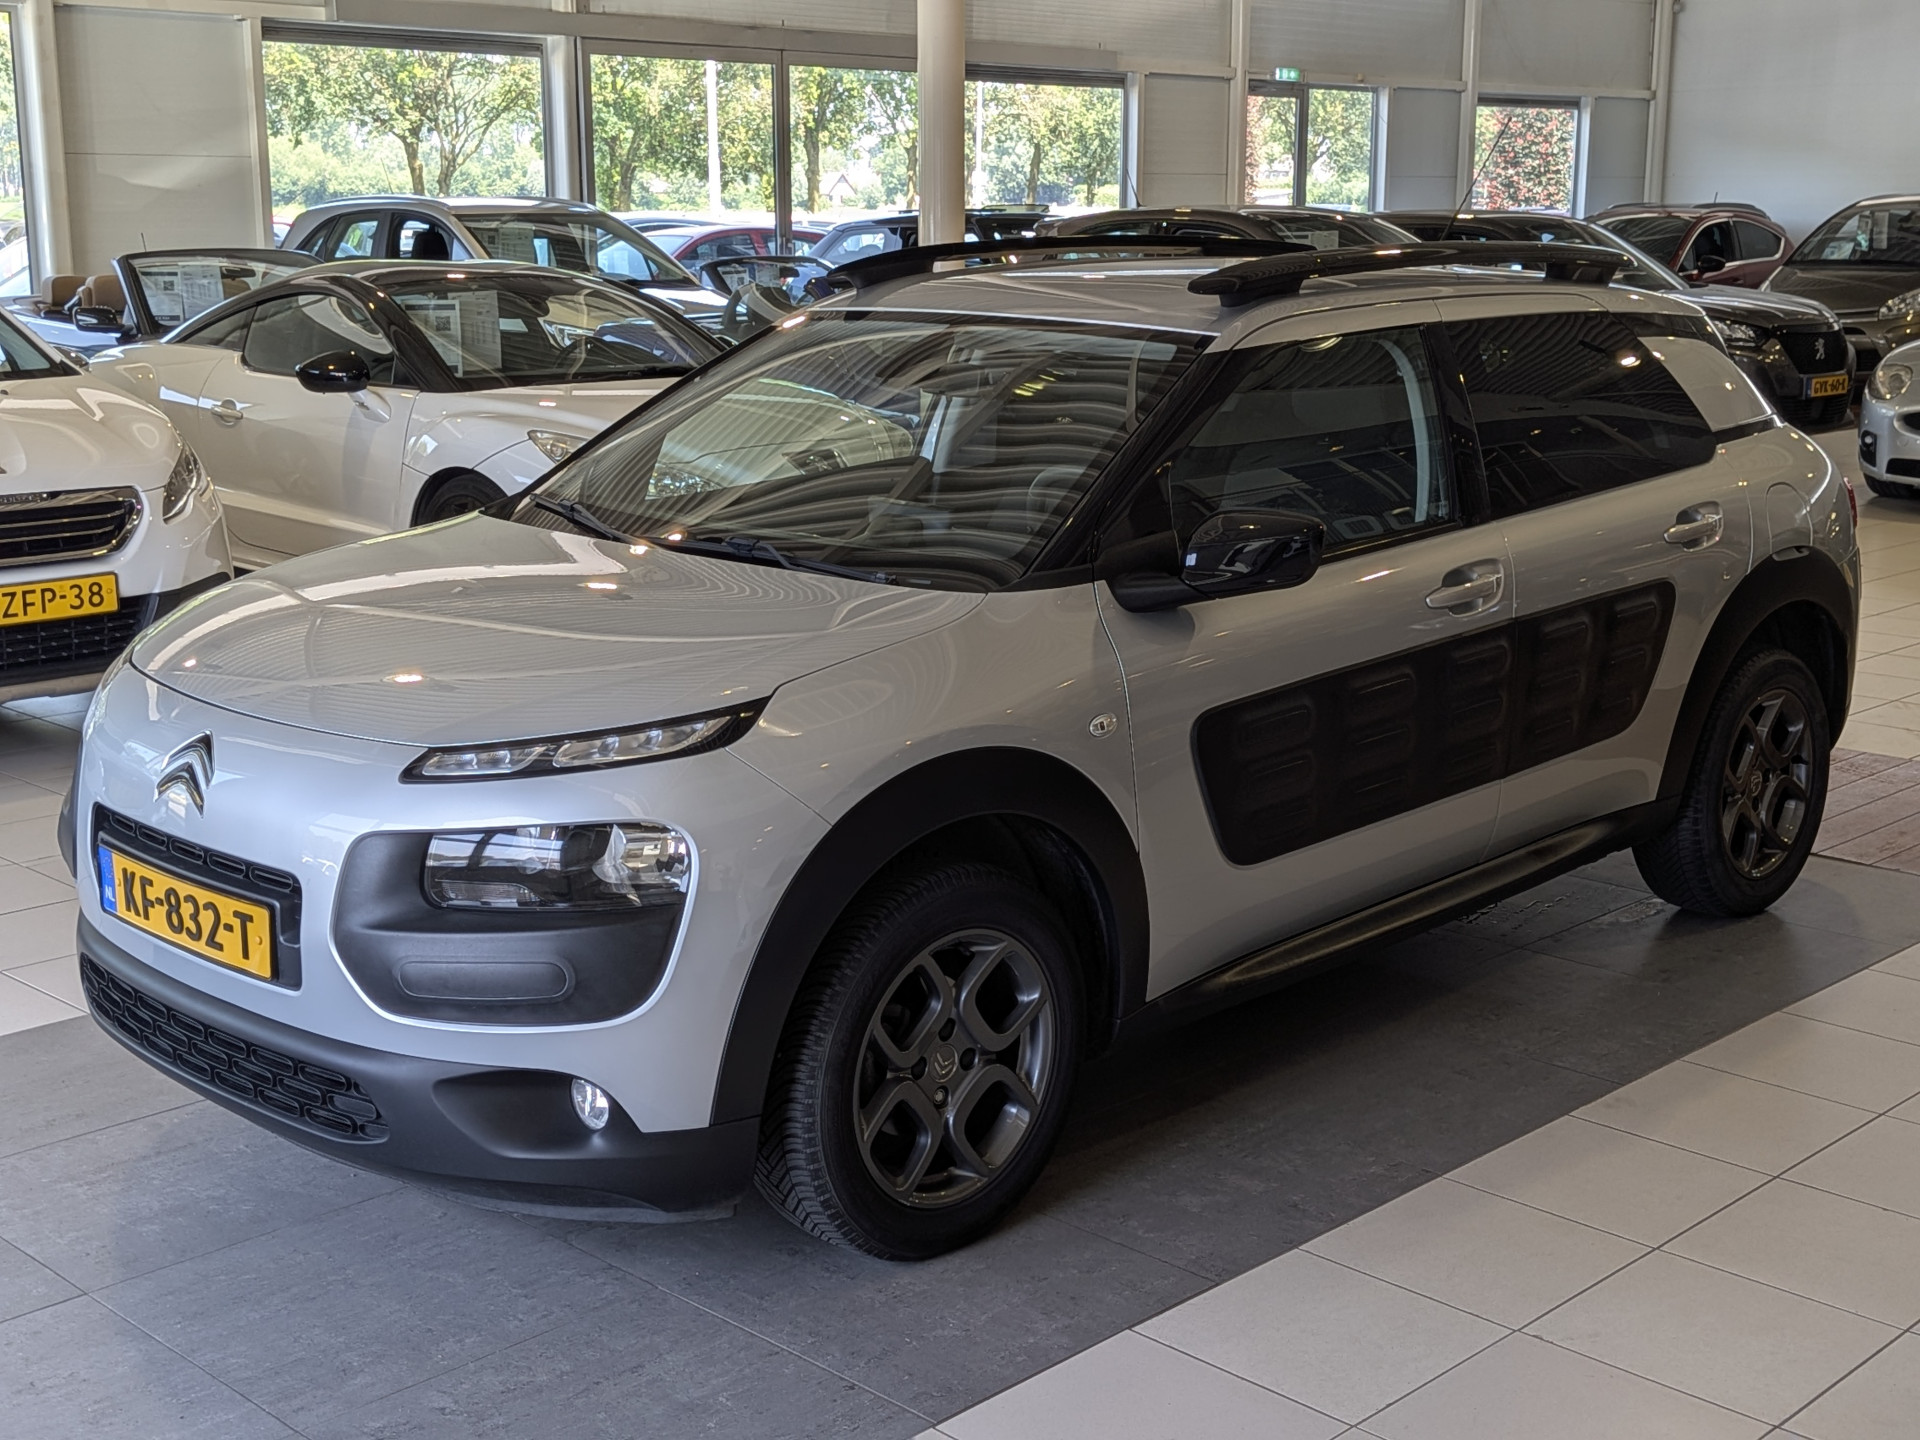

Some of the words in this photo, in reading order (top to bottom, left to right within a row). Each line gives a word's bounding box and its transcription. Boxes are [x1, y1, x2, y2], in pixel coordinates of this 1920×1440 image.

[1, 581, 104, 619] ZFP-38
[105, 885, 115, 902] NL
[122, 867, 254, 960] KF-832-T
